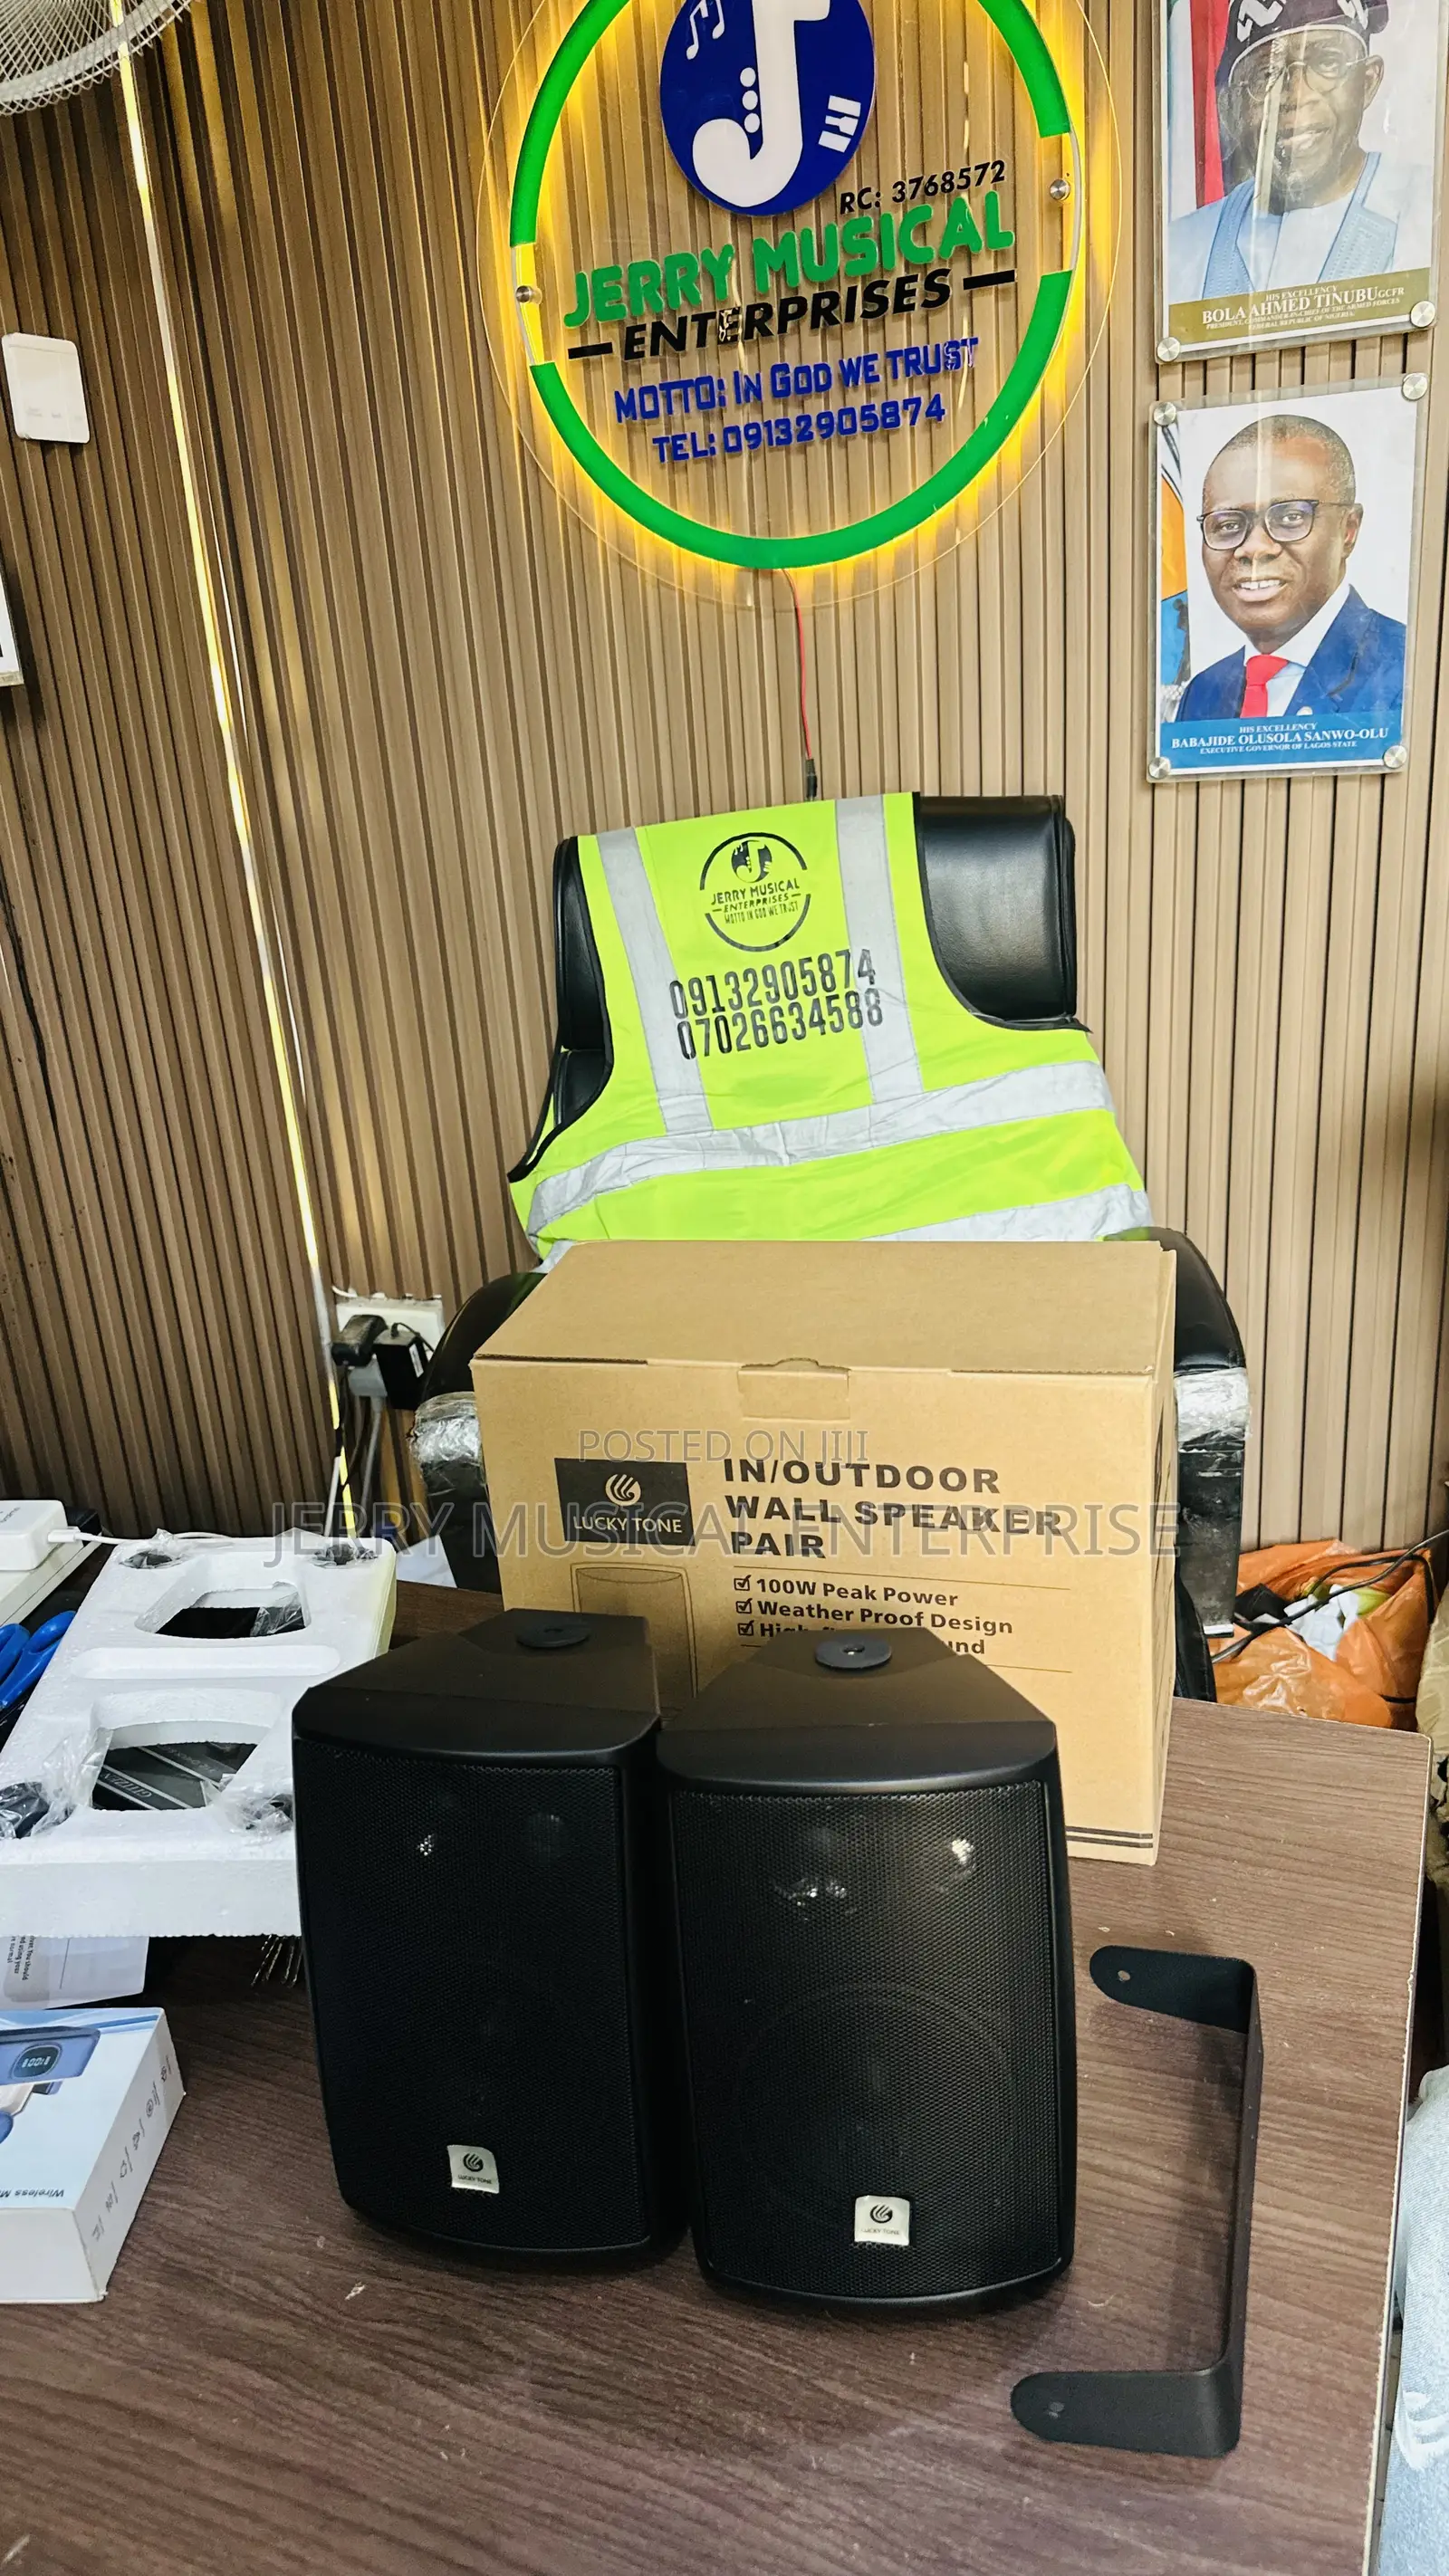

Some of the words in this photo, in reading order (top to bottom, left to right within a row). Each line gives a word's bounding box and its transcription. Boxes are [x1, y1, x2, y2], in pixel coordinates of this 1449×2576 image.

[839, 187, 882, 215] RC:
[890, 159, 1007, 203] 3768572
[562, 244, 735, 329] JERRY
[751, 190, 1015, 294] MUSICAL
[1265, 292, 1280, 302] HIS
[1281, 285, 1338, 300] EXCELLENCY
[1346, 302, 1372, 311] ARMED
[1373, 297, 1401, 308] FORCES
[623, 268, 953, 361] ENTERPRISES
[1202, 306, 1247, 324] BOLA
[1249, 297, 1310, 317] AHMED
[613, 375, 726, 424] MOTTO:
[839, 351, 880, 389] WE
[885, 337, 980, 381] TRUST
[653, 432, 716, 464] TEL:
[722, 393, 945, 455] 09132905874
[1171, 734, 1236, 750] BABAJIDE
[1238, 731, 1302, 745] OLUSOLA
[1303, 727, 1389, 742] SANWO-OLU
[1239, 726, 1255, 734] HIS
[1256, 722, 1318, 733] EXCELLENCY
[1200, 745, 1244, 755] EXECUTIVE
[1245, 742, 1291, 752] GOVERNOR
[1291, 742, 1302, 751] OF
[1304, 742, 1331, 750] LAGOS
[1332, 740, 1358, 748] STATE
[711, 887, 747, 906] JERRY
[750, 877, 800, 898] MUSICAL
[724, 892, 790, 913] ENTERPRISES
[724, 911, 745, 924] MOTTO
[746, 909, 754, 921] IN
[768, 905, 779, 917] WE
[779, 900, 799, 915] TRUST
[669, 948, 877, 1020] 09132905874
[677, 987, 884, 1060] 07026634588
[724, 1458, 1001, 1494] IN/OUTDOOR
[572, 1514, 632, 1533] LUCKY
[632, 1517, 684, 1535] TONE
[724, 1494, 841, 1524] WALL
[853, 1499, 1062, 1537] SPEAKER
[730, 1530, 828, 1560] PAIR
[756, 1577, 816, 1595] 100W
[822, 1582, 878, 1601] Peak
[884, 1586, 958, 1606] Power
[758, 1600, 854, 1622] Weather
[859, 1606, 924, 1627] Proof
[930, 1613, 1013, 1635] Design
[14, 2188, 64, 2198] Wireless
